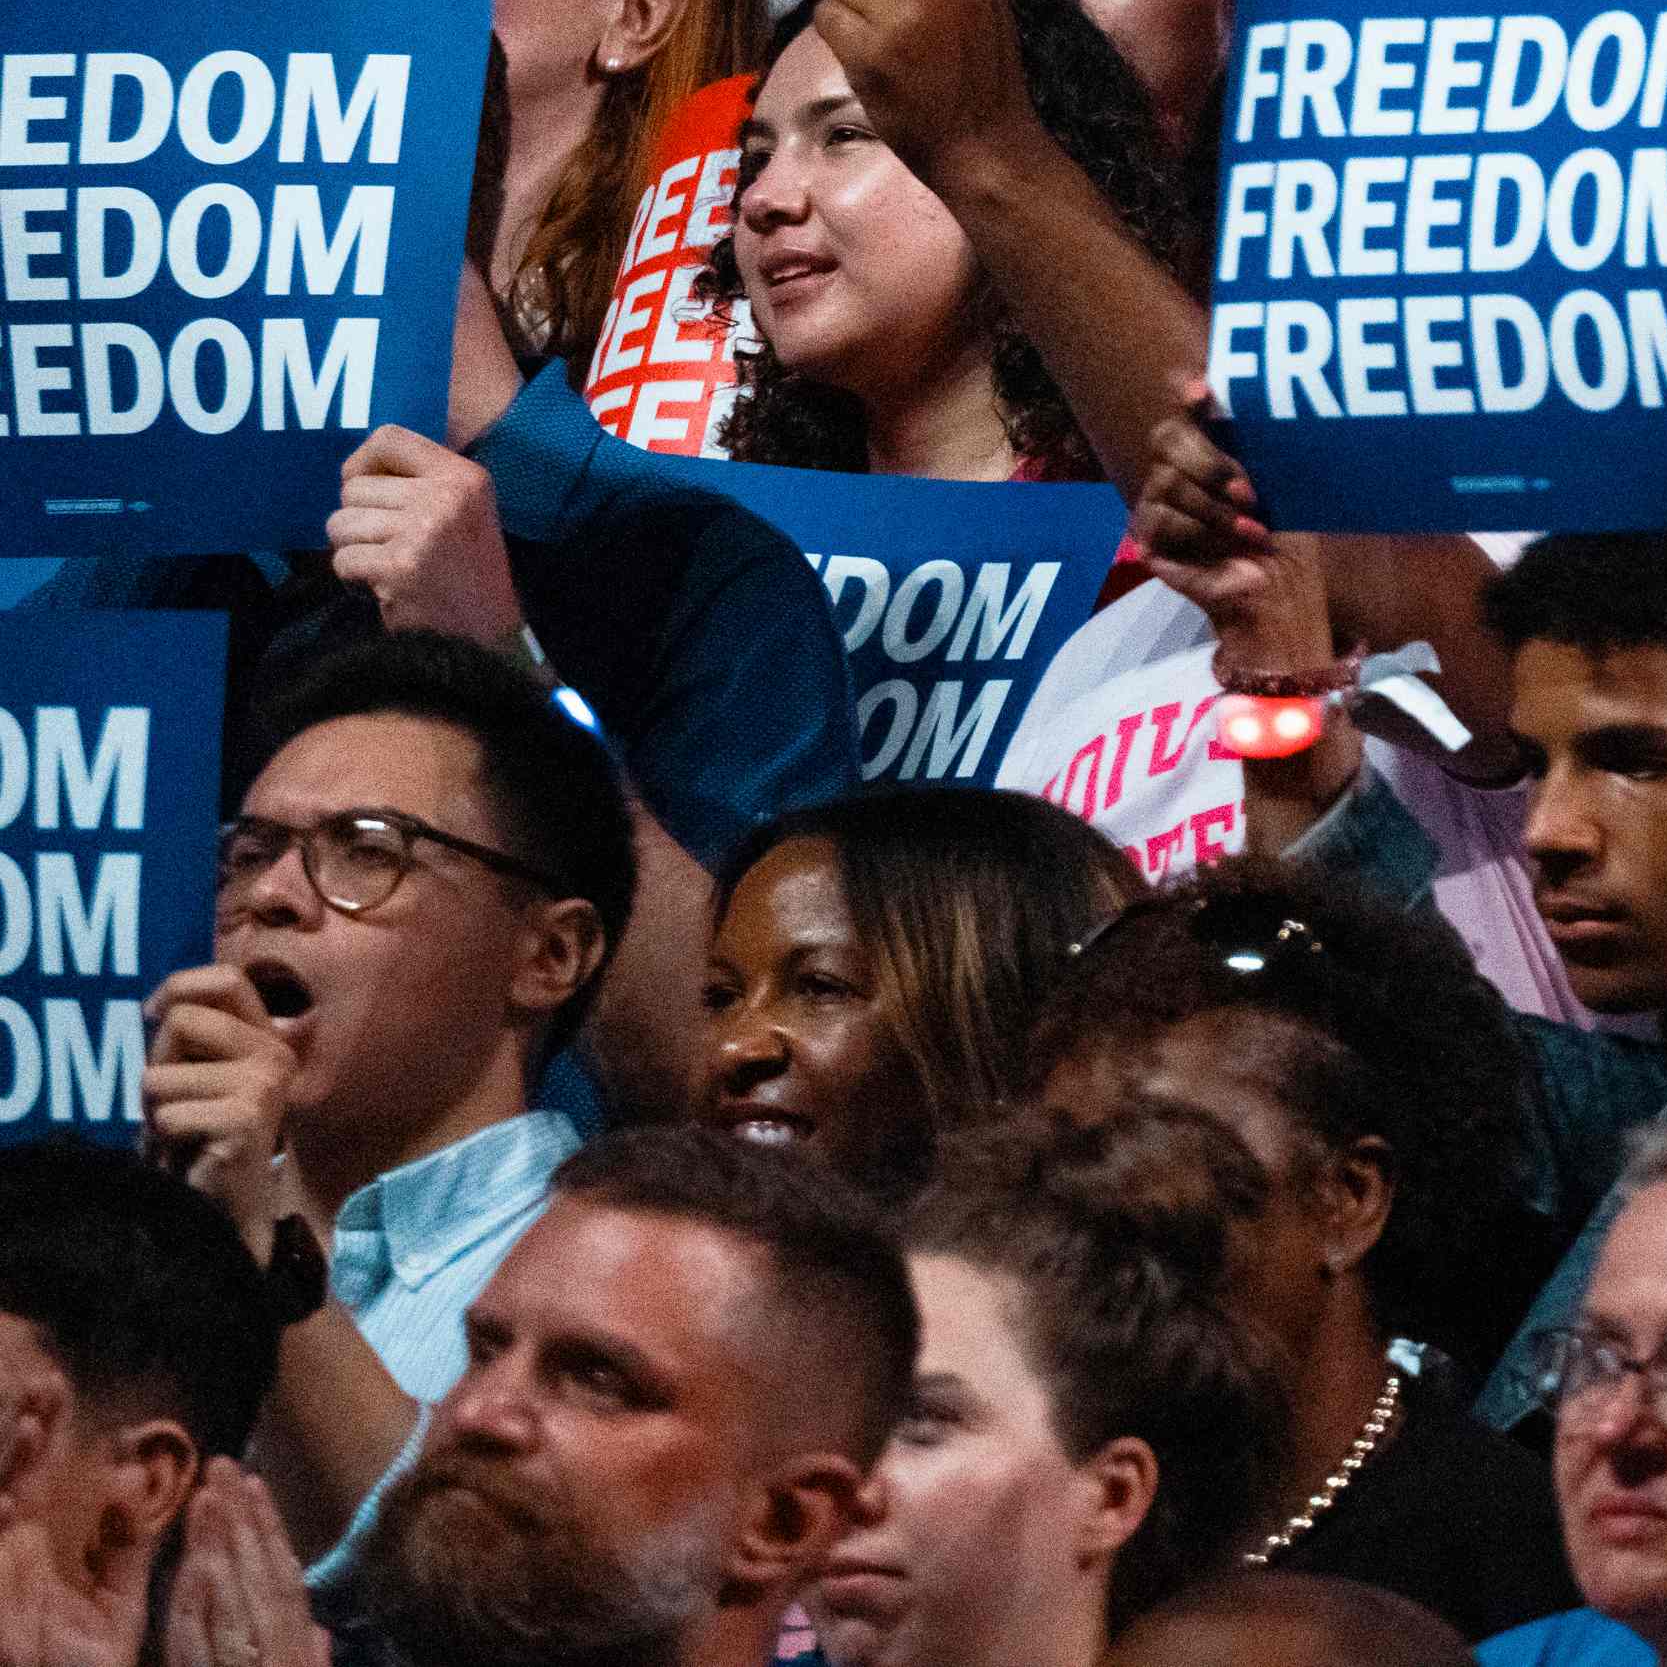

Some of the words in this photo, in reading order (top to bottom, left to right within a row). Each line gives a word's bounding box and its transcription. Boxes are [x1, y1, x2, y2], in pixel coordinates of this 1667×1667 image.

[2, 51, 411, 167] EDOM
[4, 185, 395, 300] EDOM
[0, 316, 380, 435] EDOM
[806, 553, 1060, 663] DOM
